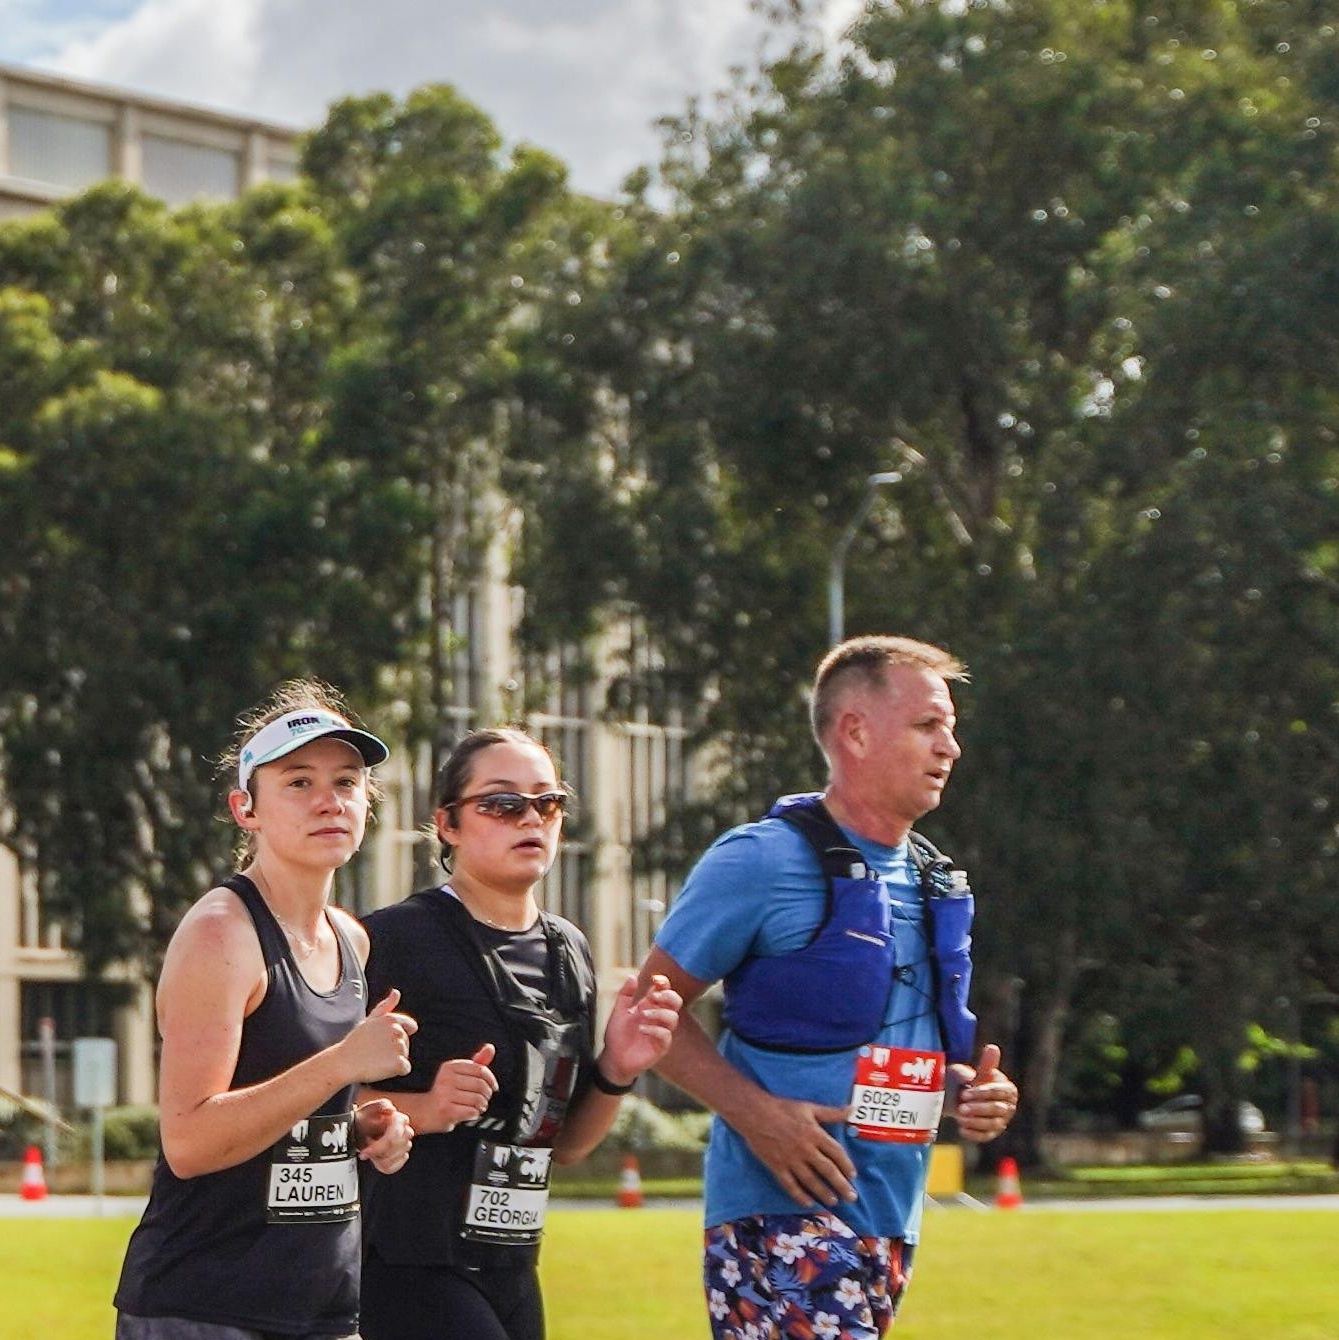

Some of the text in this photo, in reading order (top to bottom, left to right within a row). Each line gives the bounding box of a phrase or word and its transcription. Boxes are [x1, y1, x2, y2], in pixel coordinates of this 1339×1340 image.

[862, 1089, 901, 1107] 6029
[855, 1105, 919, 1125] STEVEN
[279, 1167, 313, 1183] 345
[275, 1184, 345, 1202] LAUREN
[481, 1189, 510, 1207] 702
